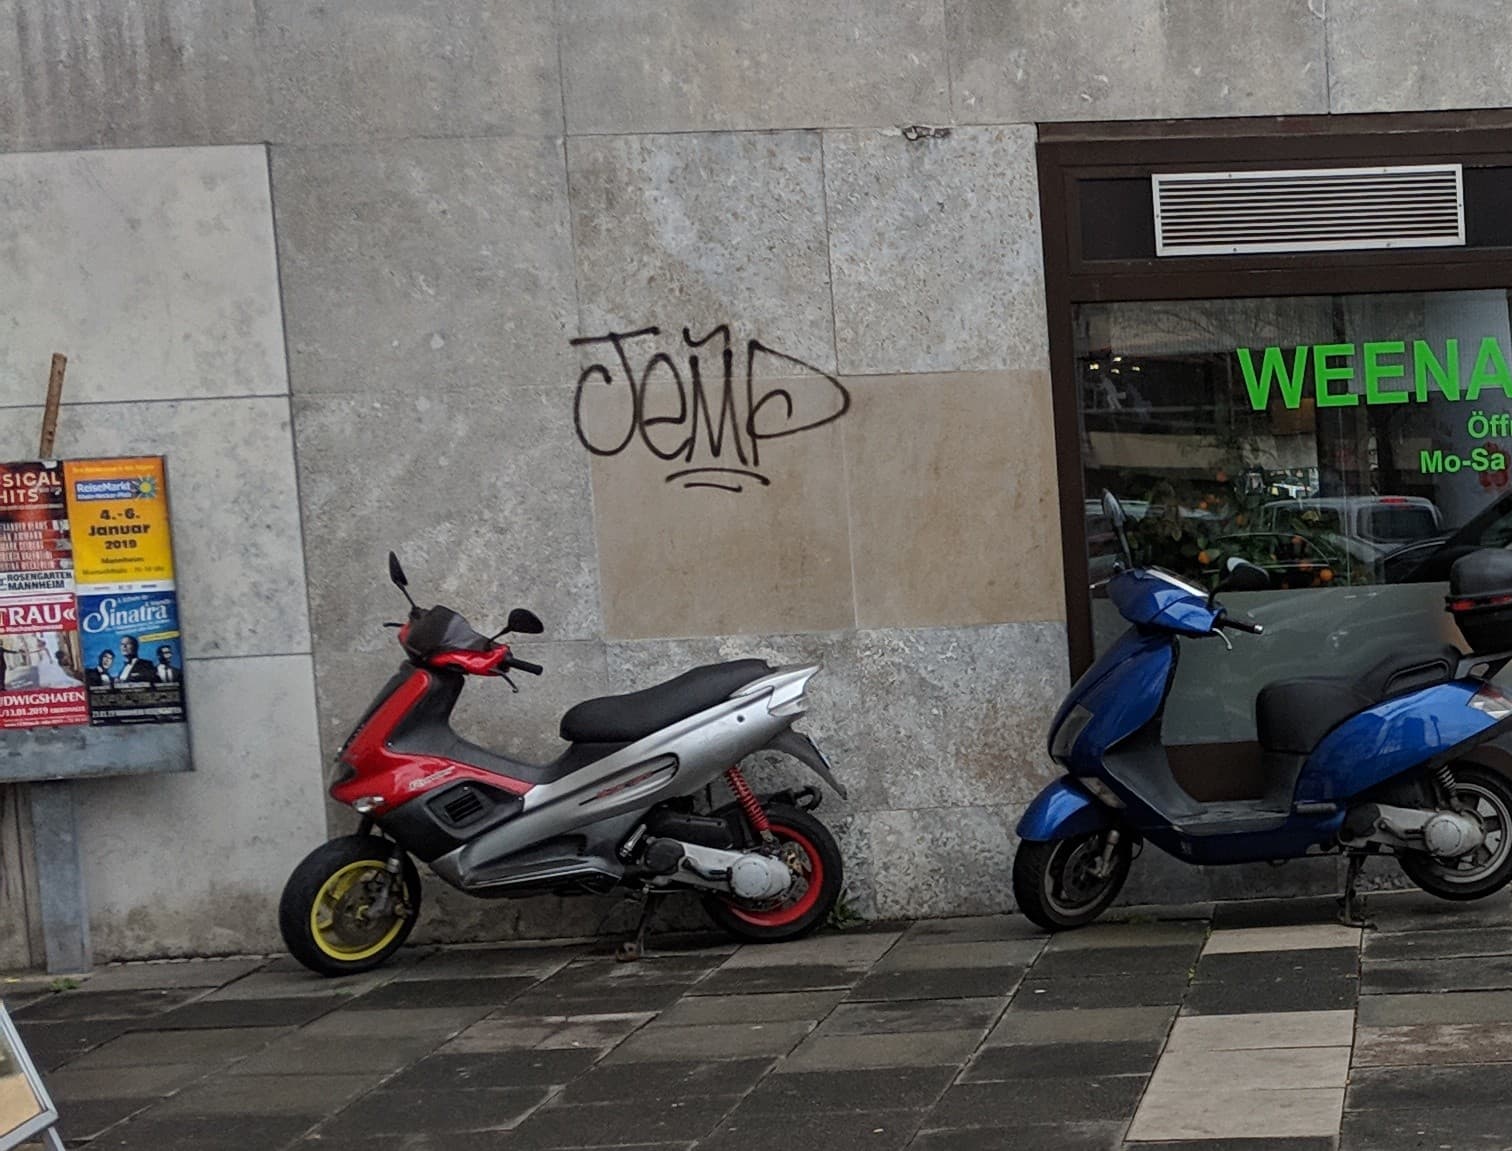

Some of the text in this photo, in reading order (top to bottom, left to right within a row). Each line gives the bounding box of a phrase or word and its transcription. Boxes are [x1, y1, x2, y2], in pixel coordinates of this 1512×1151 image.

[1420, 446, 1506, 474] Mo-Sa
[88, 524, 151, 536] Januar
[104, 539, 137, 550] 2019
[7, 570, 72, 583] ROSENGARTEN
[8, 580, 65, 591] MANNHEIM
[83, 598, 168, 633] Sinatra
